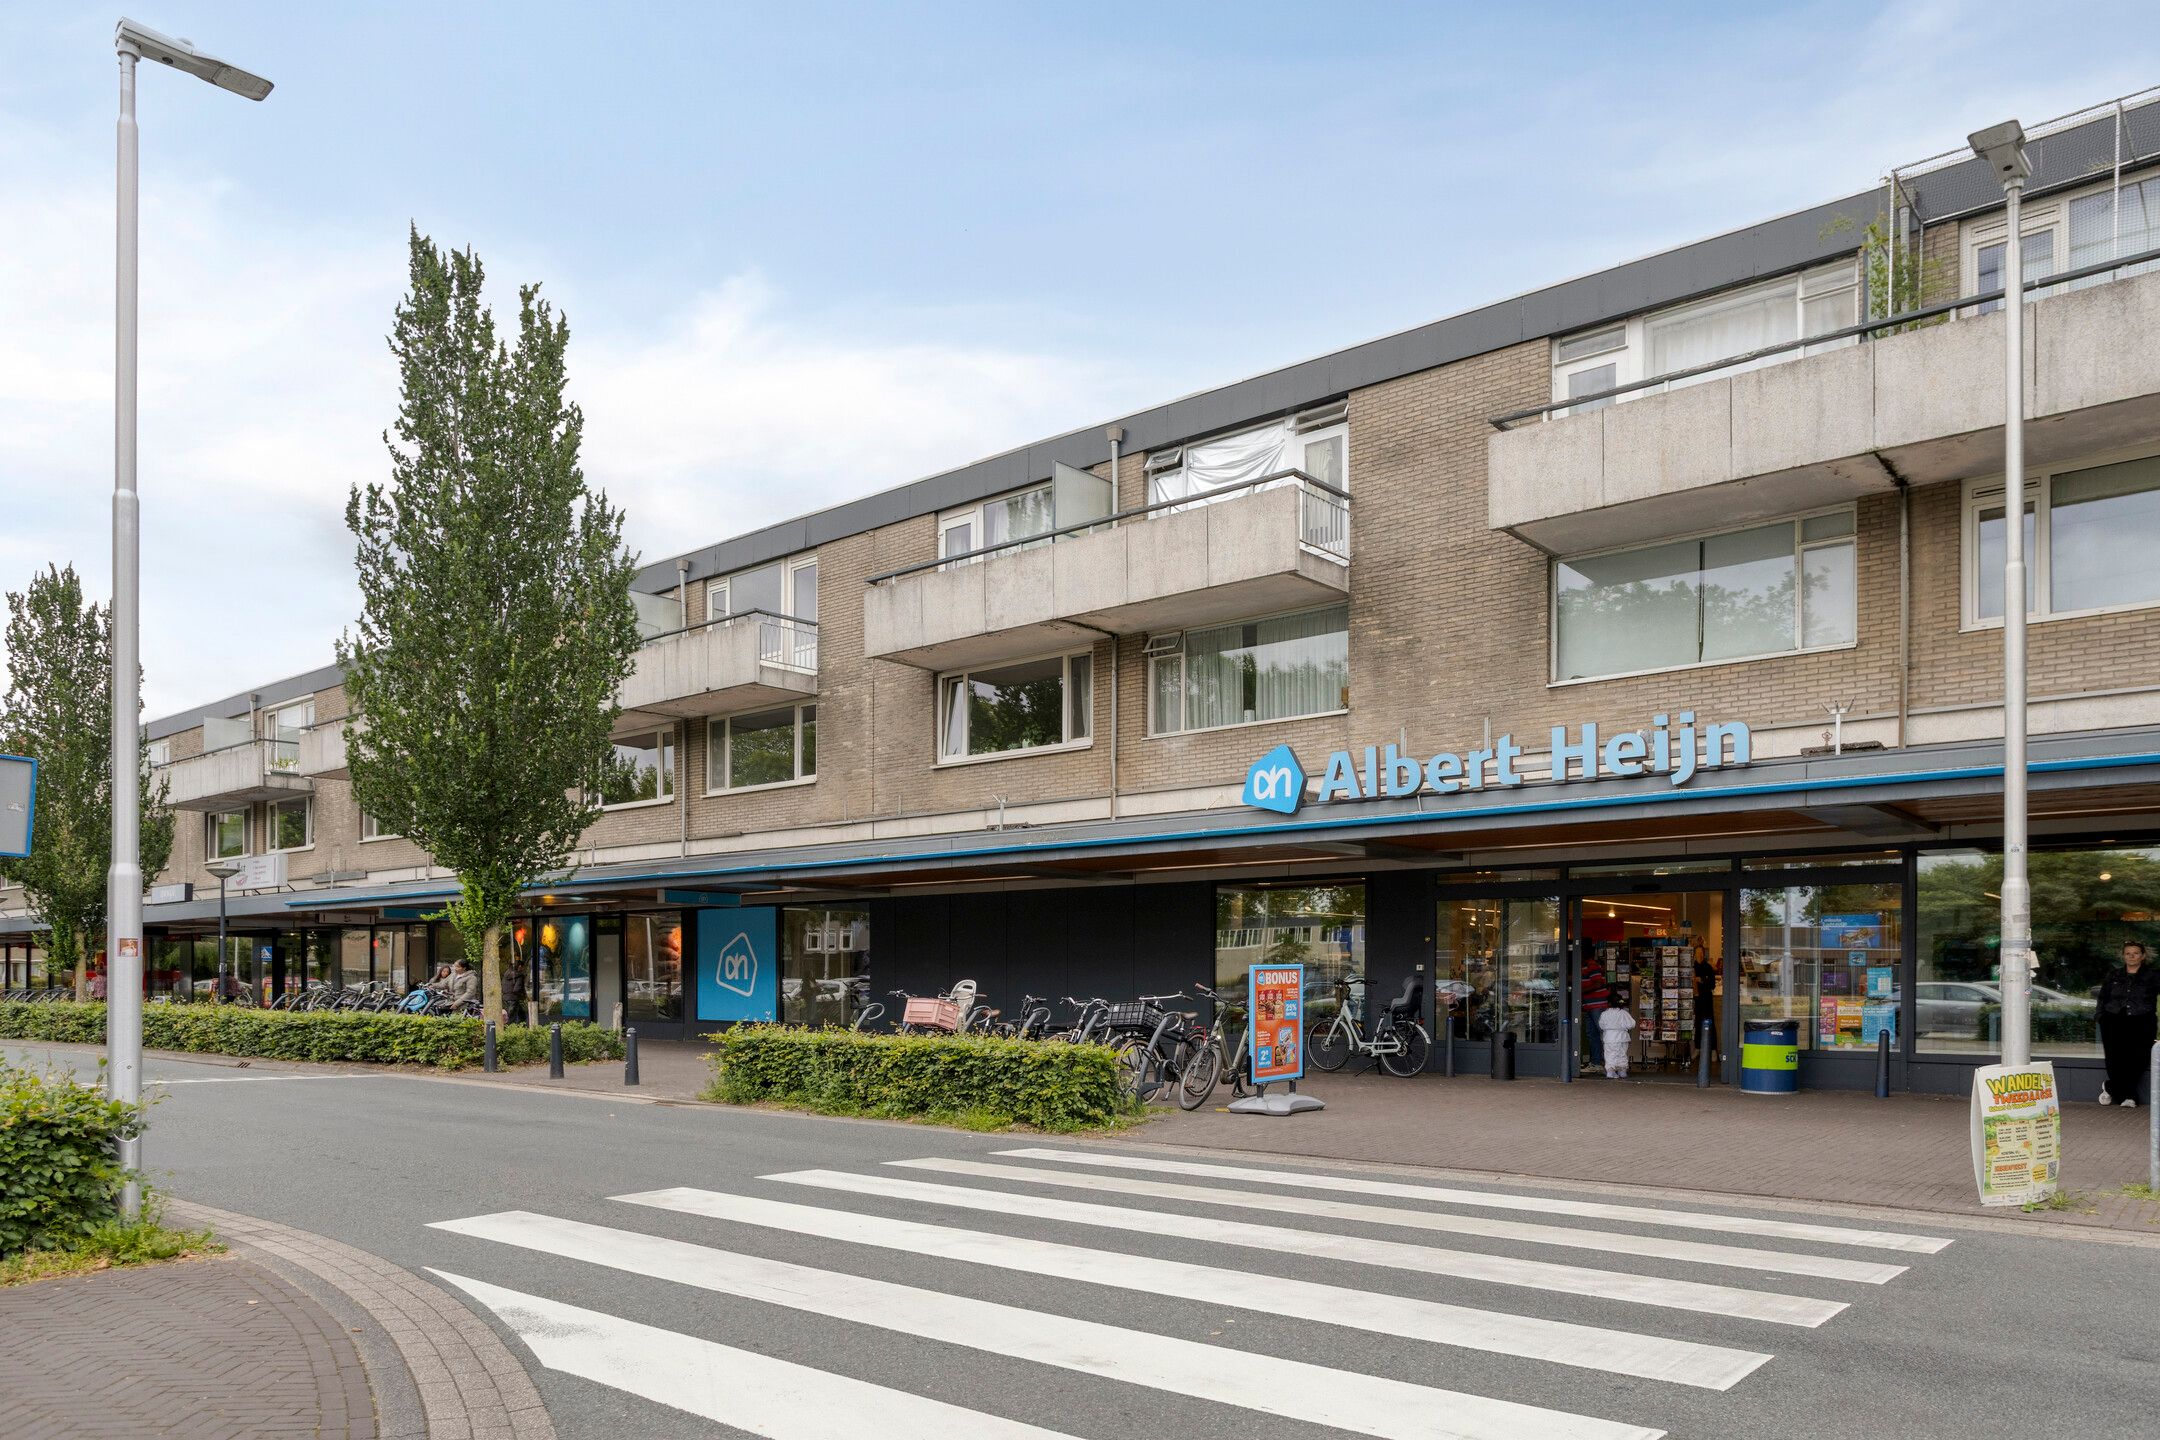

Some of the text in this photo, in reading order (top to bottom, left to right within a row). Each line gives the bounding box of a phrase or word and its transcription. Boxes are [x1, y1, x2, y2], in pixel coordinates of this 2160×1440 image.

[1317, 734, 1524, 802] Albert
[1551, 711, 1752, 787] Heijn
[1265, 971, 1298, 985] BONUS
[1985, 1073, 2043, 1095] WANDEL
